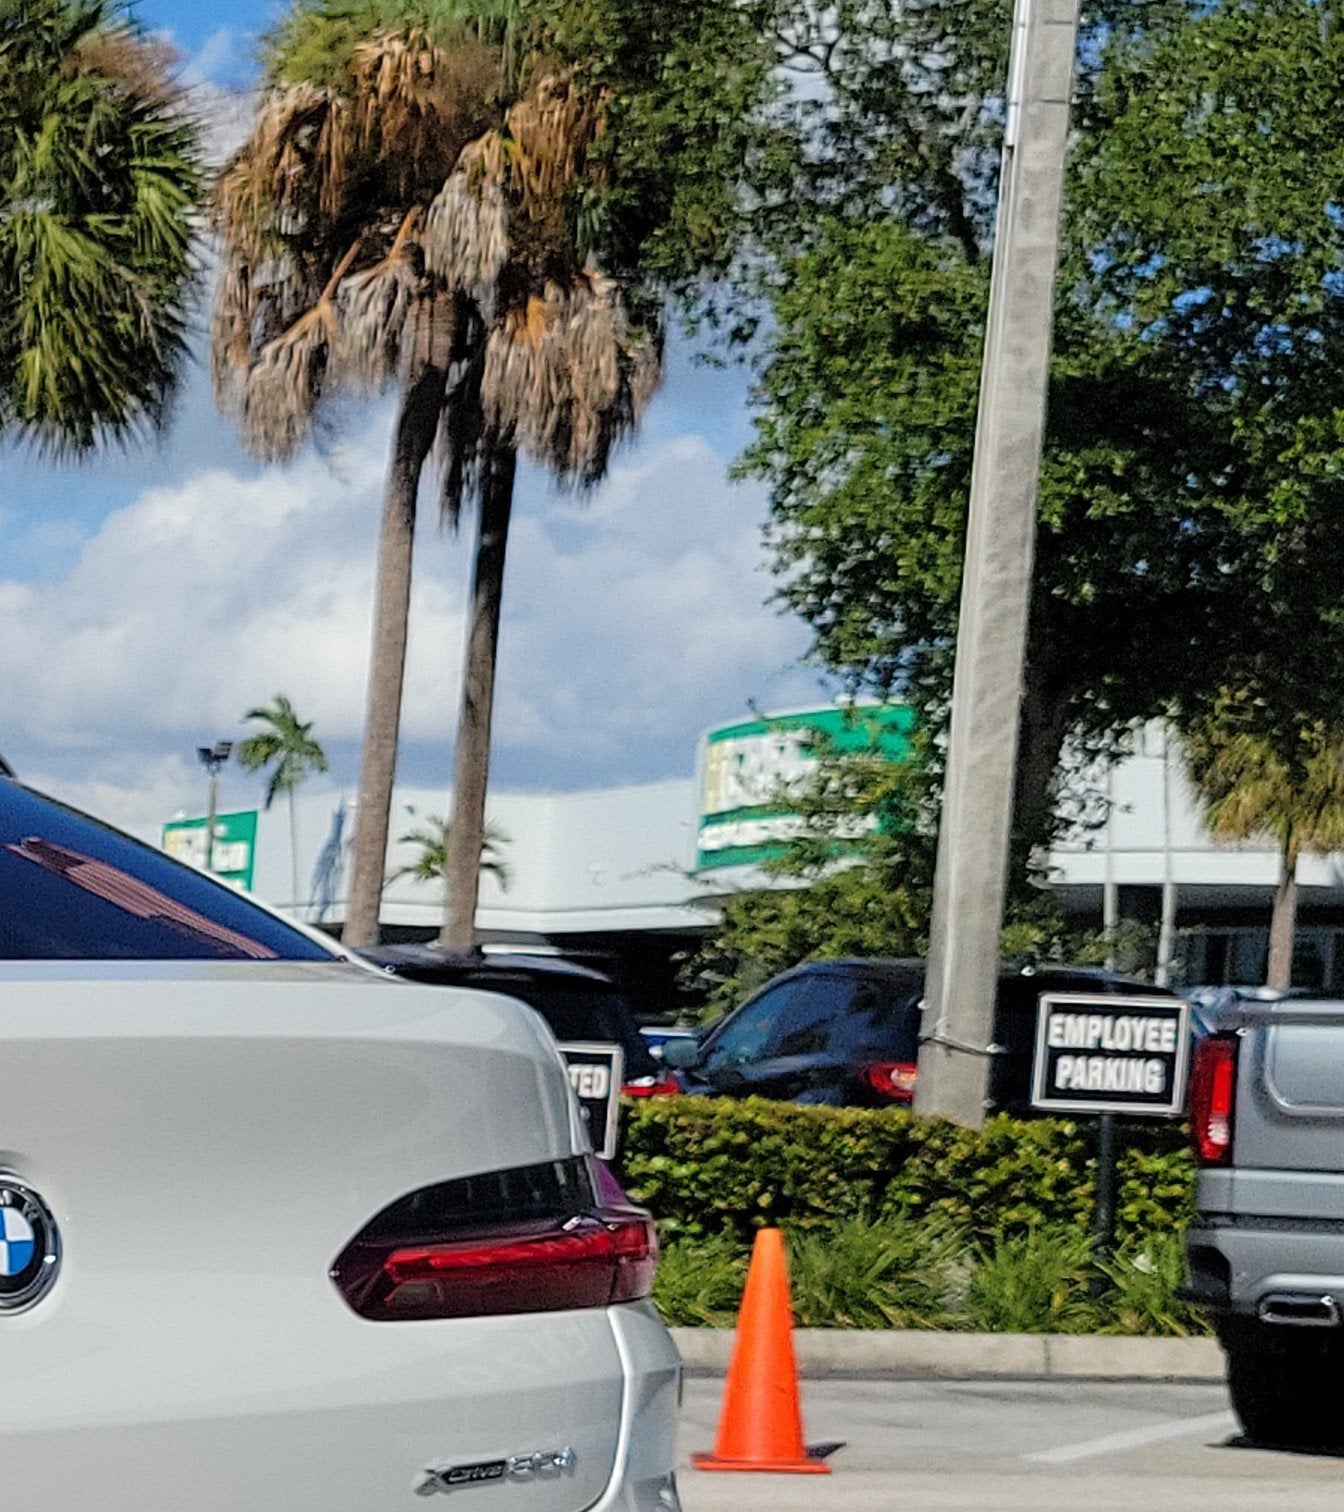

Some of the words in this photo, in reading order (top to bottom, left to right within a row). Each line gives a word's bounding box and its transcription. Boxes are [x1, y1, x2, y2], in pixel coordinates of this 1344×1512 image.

[1048, 1013, 1177, 1053] EMPLOYEE
[568, 1063, 610, 1099] TED
[1055, 1055, 1166, 1093] PARKING
